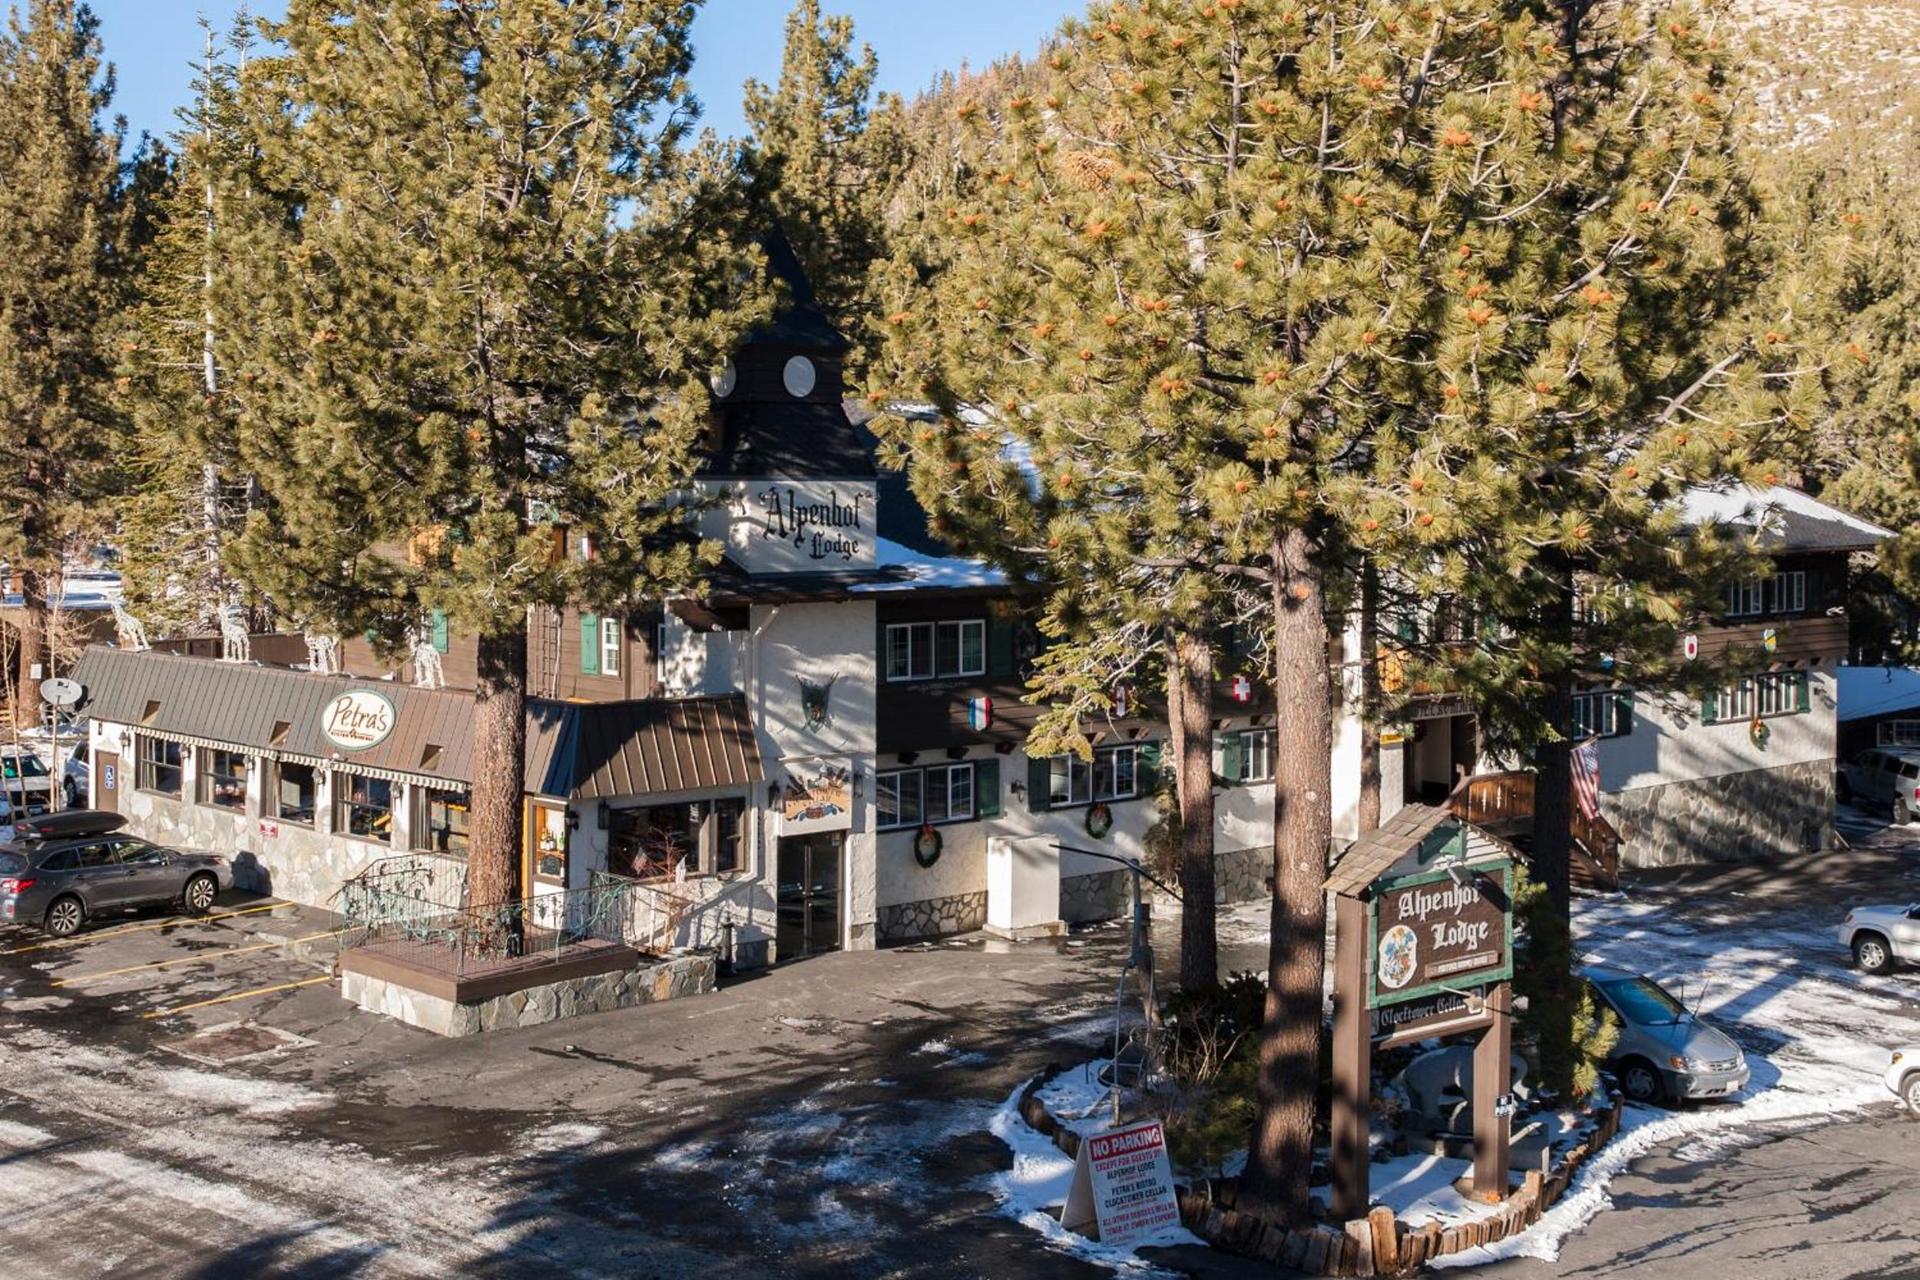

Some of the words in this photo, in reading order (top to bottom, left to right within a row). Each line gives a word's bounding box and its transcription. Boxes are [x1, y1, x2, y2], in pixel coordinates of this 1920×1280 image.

[760, 487, 867, 548] Alpenhof
[809, 530, 859, 561] Lodge
[328, 696, 387, 732] Petra's
[1431, 920, 1488, 951] Lodge
[1437, 996, 1467, 1014] Cella
[1091, 1139, 1109, 1158] NO
[1112, 1127, 1160, 1153] PARKING
[1107, 1167, 1136, 1180] ALPENHOF
[1137, 1161, 1155, 1174] LODGE
